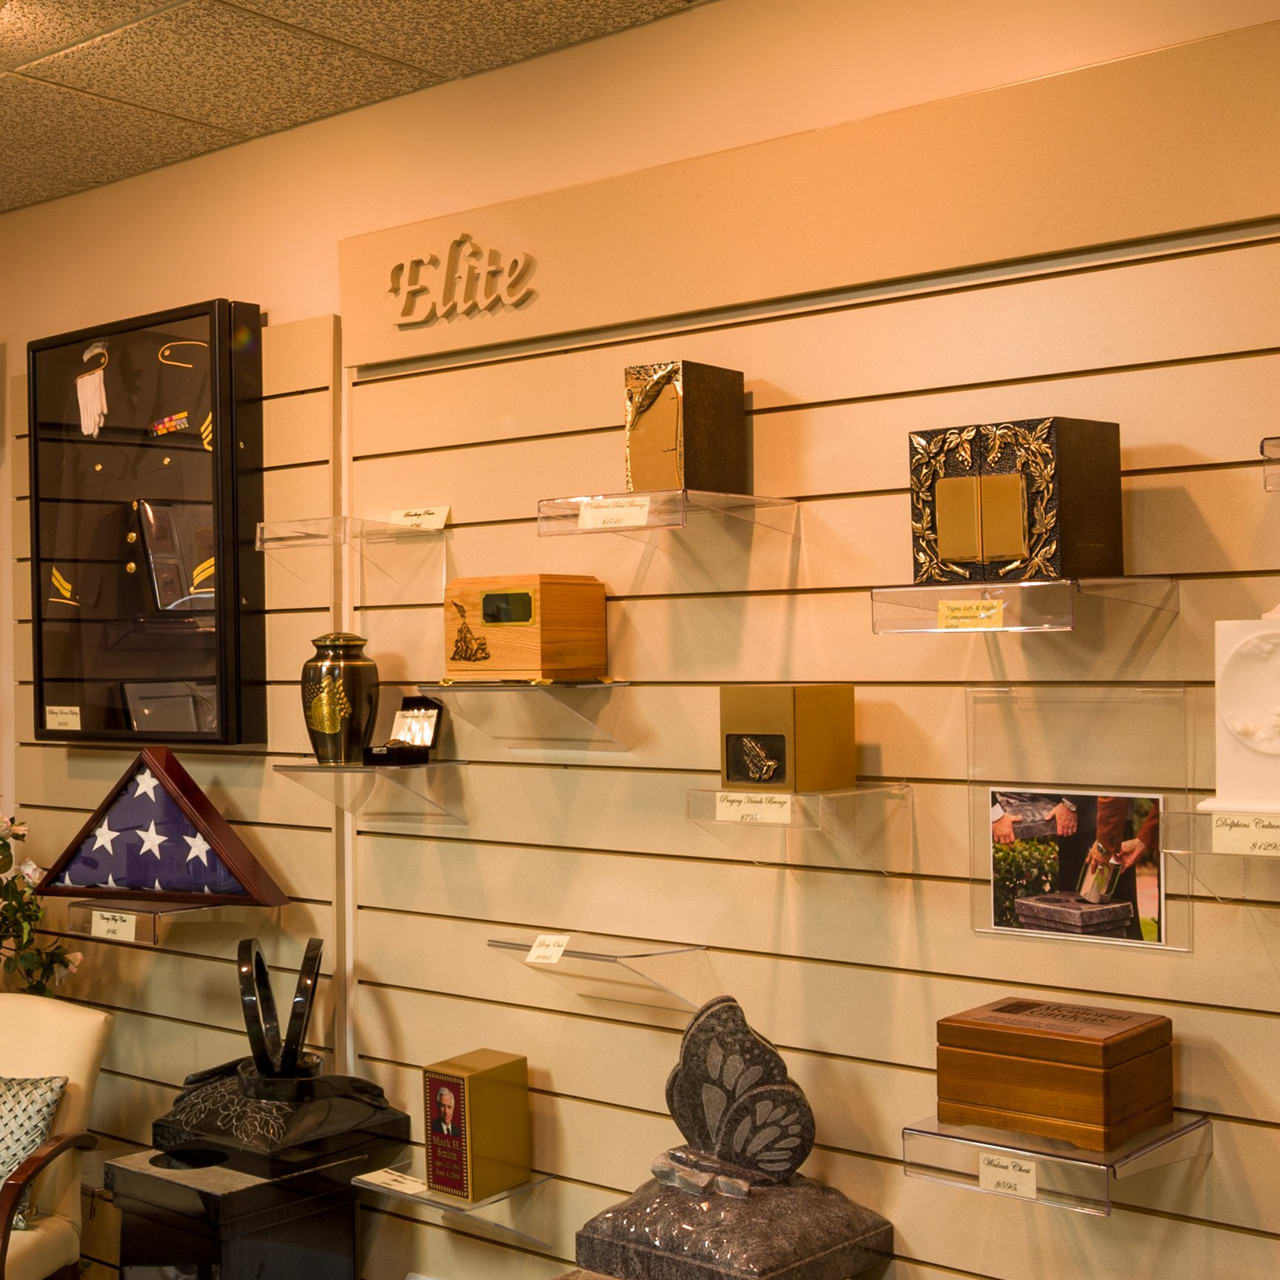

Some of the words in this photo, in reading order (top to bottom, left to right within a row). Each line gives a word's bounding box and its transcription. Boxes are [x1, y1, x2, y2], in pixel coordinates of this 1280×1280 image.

[391, 236, 536, 327] Elite
[720, 794, 743, 807] Praying
[744, 795, 764, 804] Hands
[765, 796, 788, 808] Bronze
[1215, 817, 1250, 831] Dolphins
[1040, 1004, 1133, 1022] Memorial
[432, 1135, 452, 1148] Mark
[436, 1147, 457, 1161] Smith
[983, 1157, 1010, 1170] Walnut
[1011, 1161, 1031, 1174] Chest
